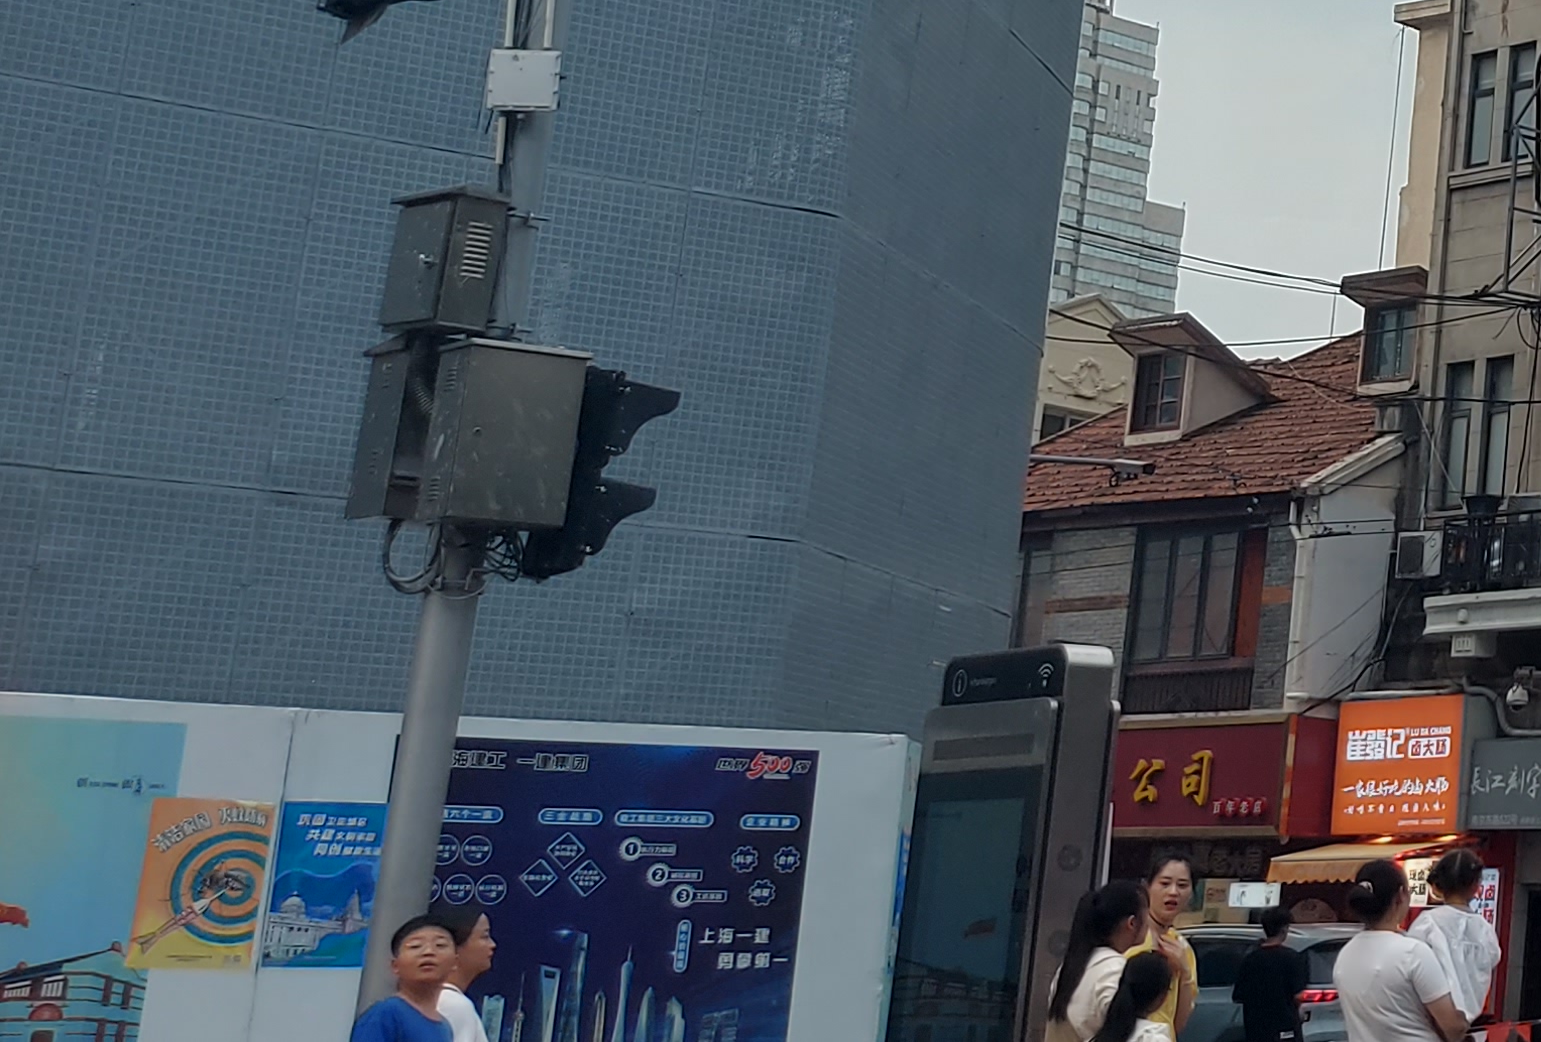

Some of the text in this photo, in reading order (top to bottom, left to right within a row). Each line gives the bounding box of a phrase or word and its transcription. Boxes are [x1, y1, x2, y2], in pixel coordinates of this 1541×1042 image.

[1129, 749, 1214, 806] 公司
[698, 927, 770, 944] 上海一建
